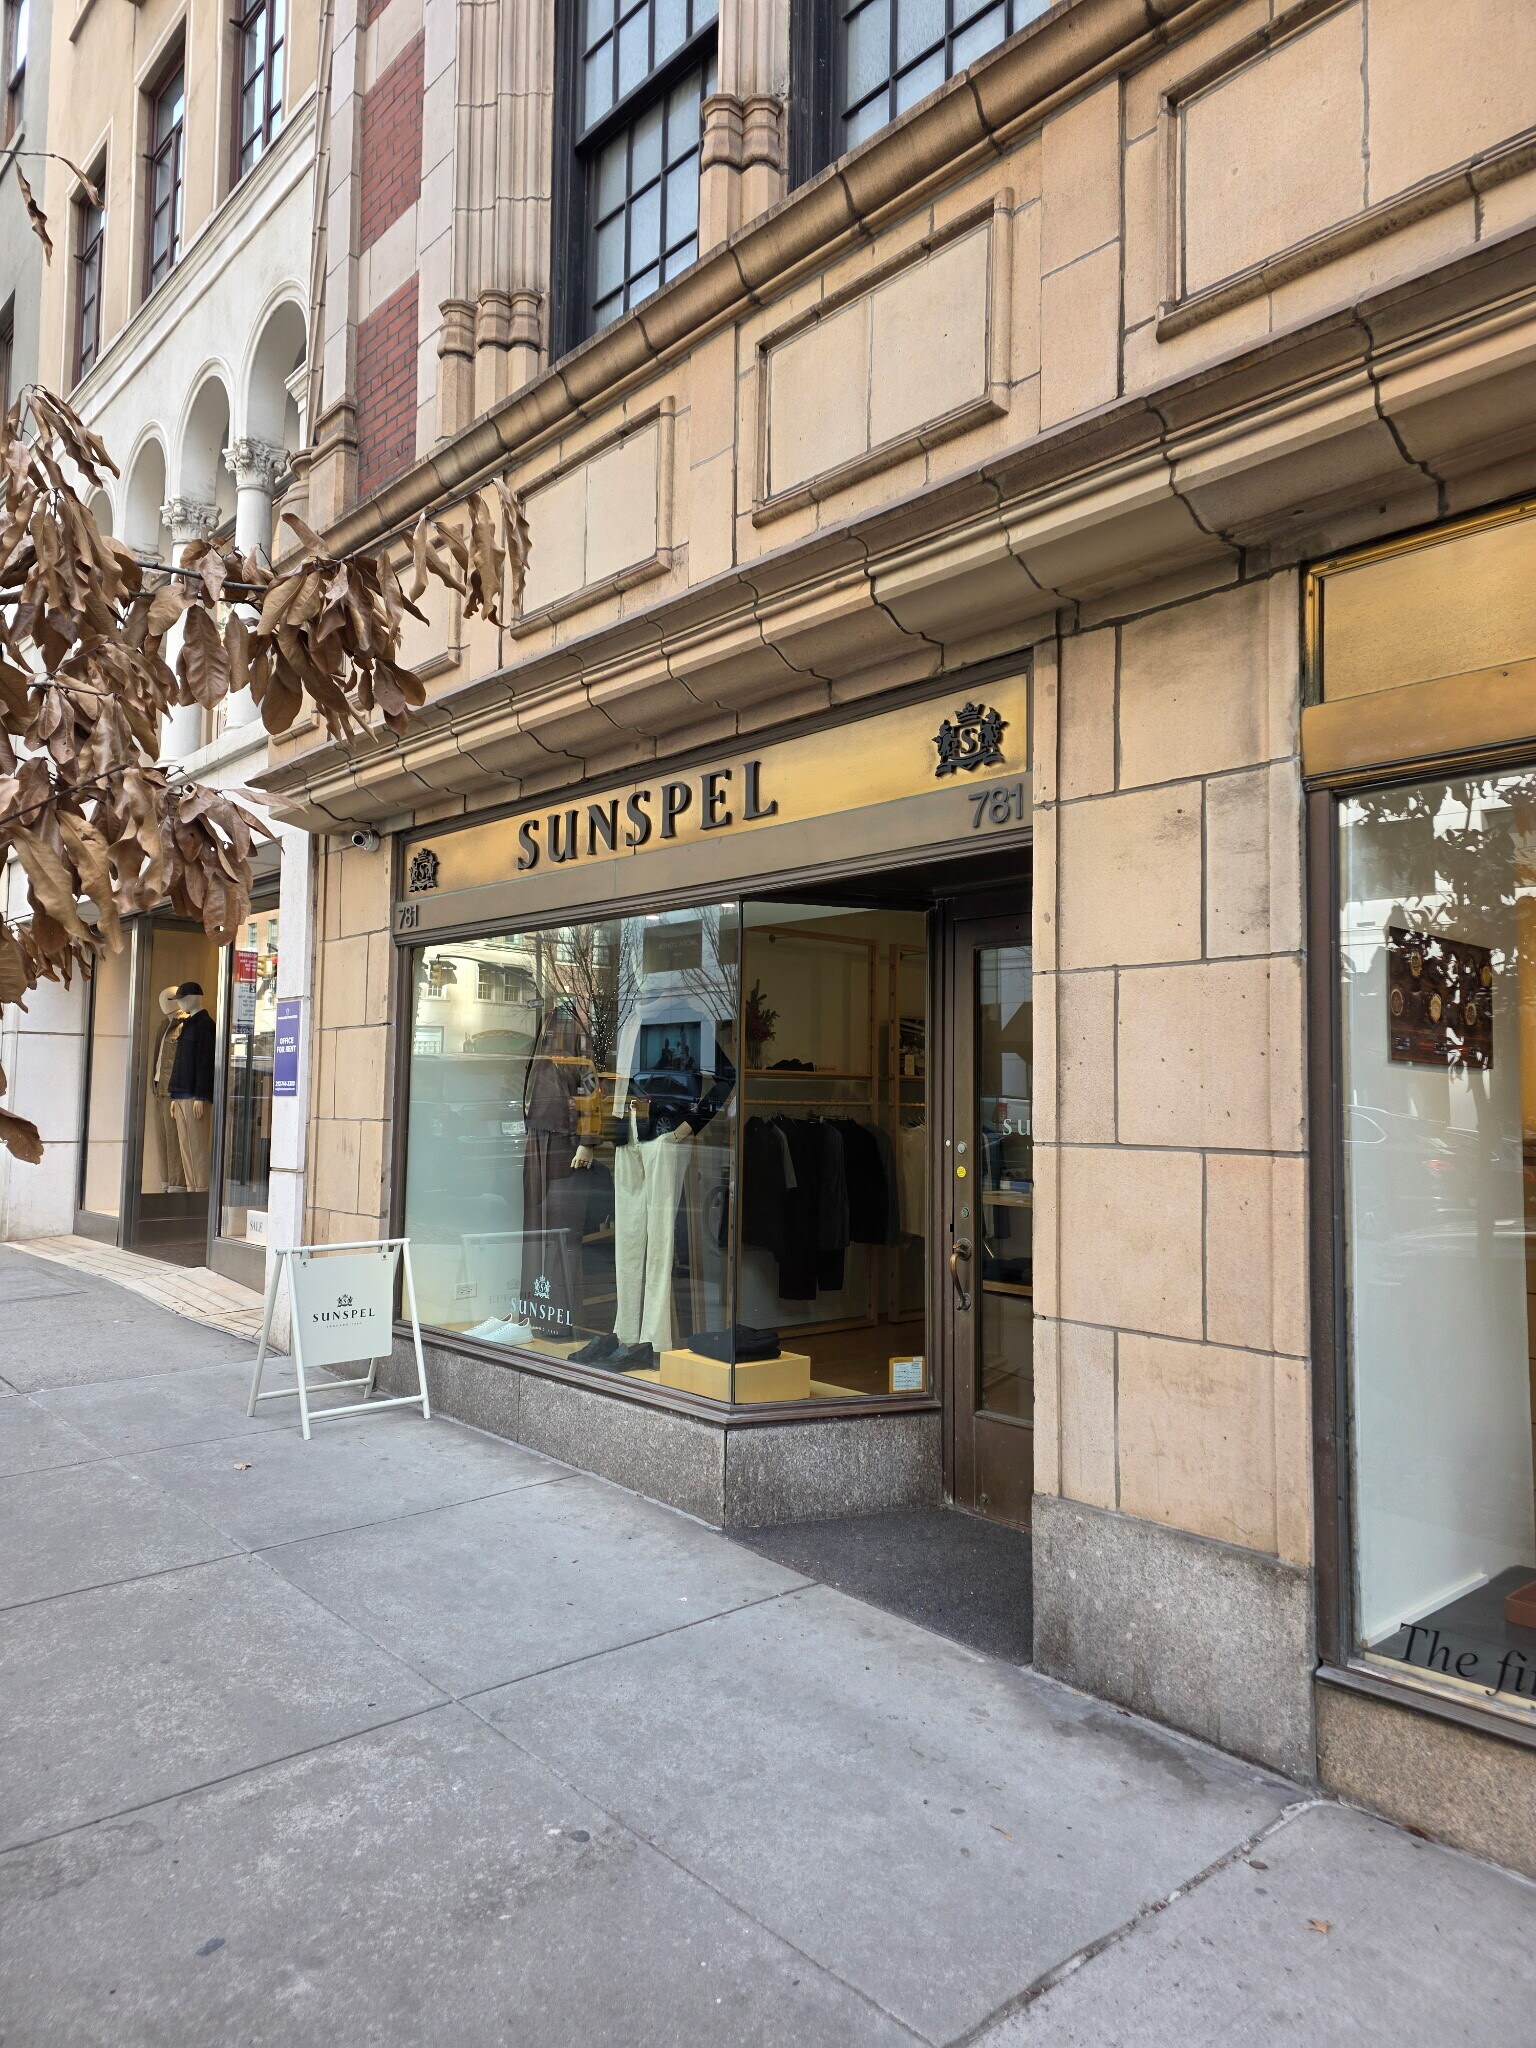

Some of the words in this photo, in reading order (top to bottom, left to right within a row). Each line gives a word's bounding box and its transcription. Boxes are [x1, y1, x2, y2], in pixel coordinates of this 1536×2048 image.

[517, 760, 779, 870] SUNSPEL
[968, 783, 1023, 829] 781
[398, 904, 419, 930] 781
[276, 1046, 286, 1054] FOR
[286, 1045, 297, 1053] RENT
[279, 1037, 295, 1045] OFFICE
[312, 1308, 375, 1323] SUNSPEL
[511, 1297, 574, 1327] SUNSPEL
[1399, 1622, 1479, 1678] The
